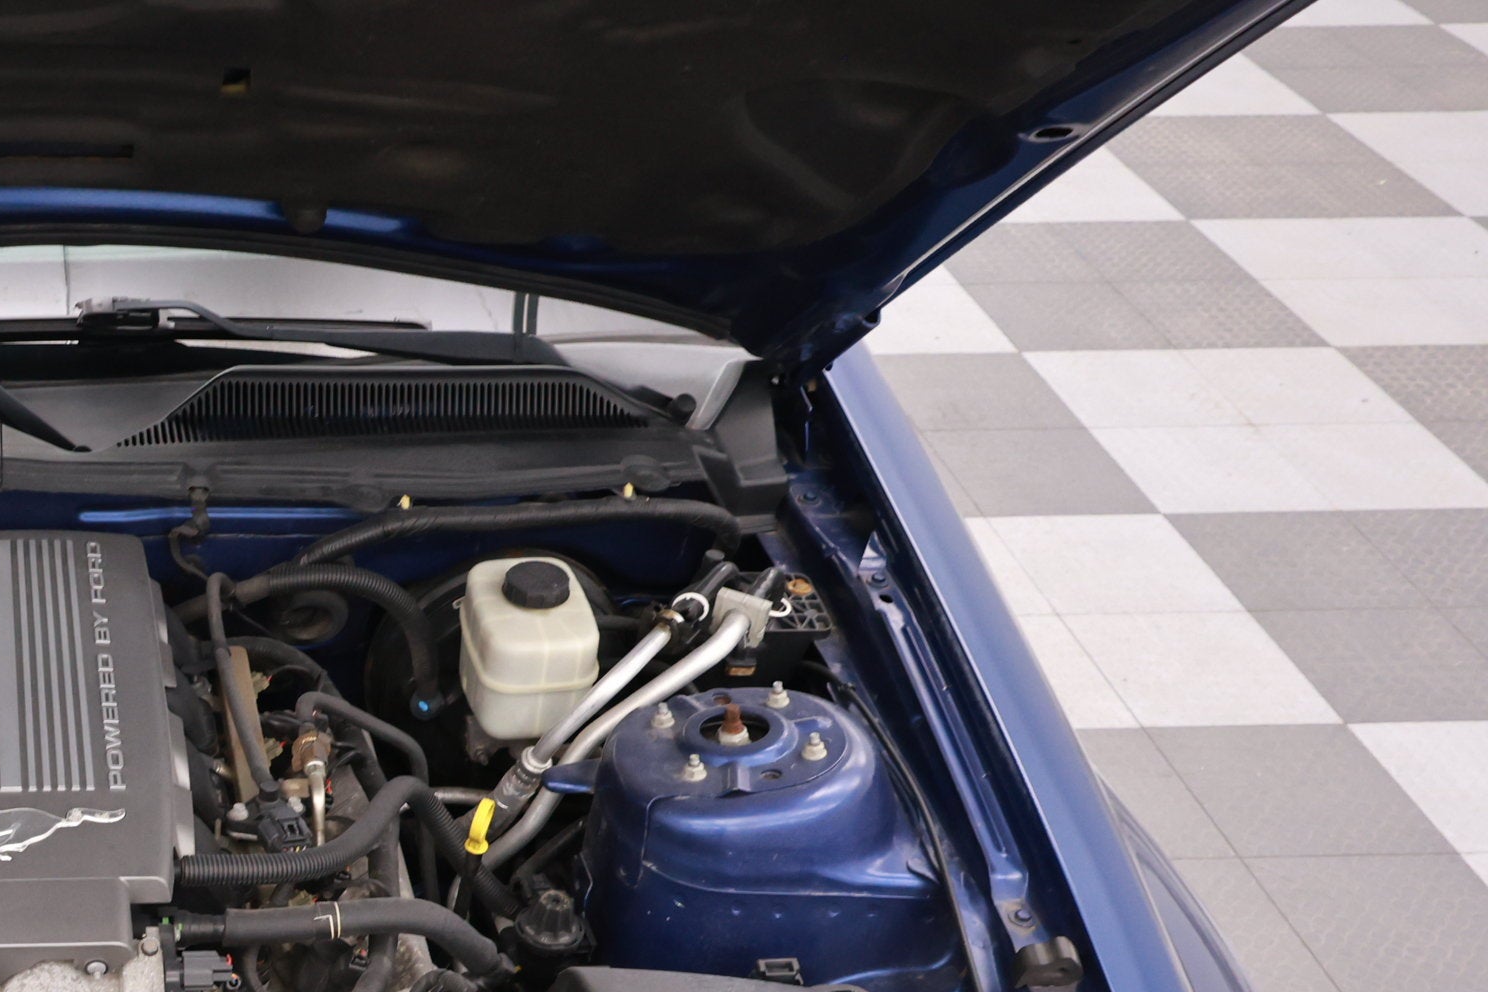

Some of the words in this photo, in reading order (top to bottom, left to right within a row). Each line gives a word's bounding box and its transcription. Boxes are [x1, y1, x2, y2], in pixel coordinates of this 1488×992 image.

[86, 541, 107, 604] FORD
[93, 612, 111, 645] BY
[97, 653, 127, 792] POWERED
